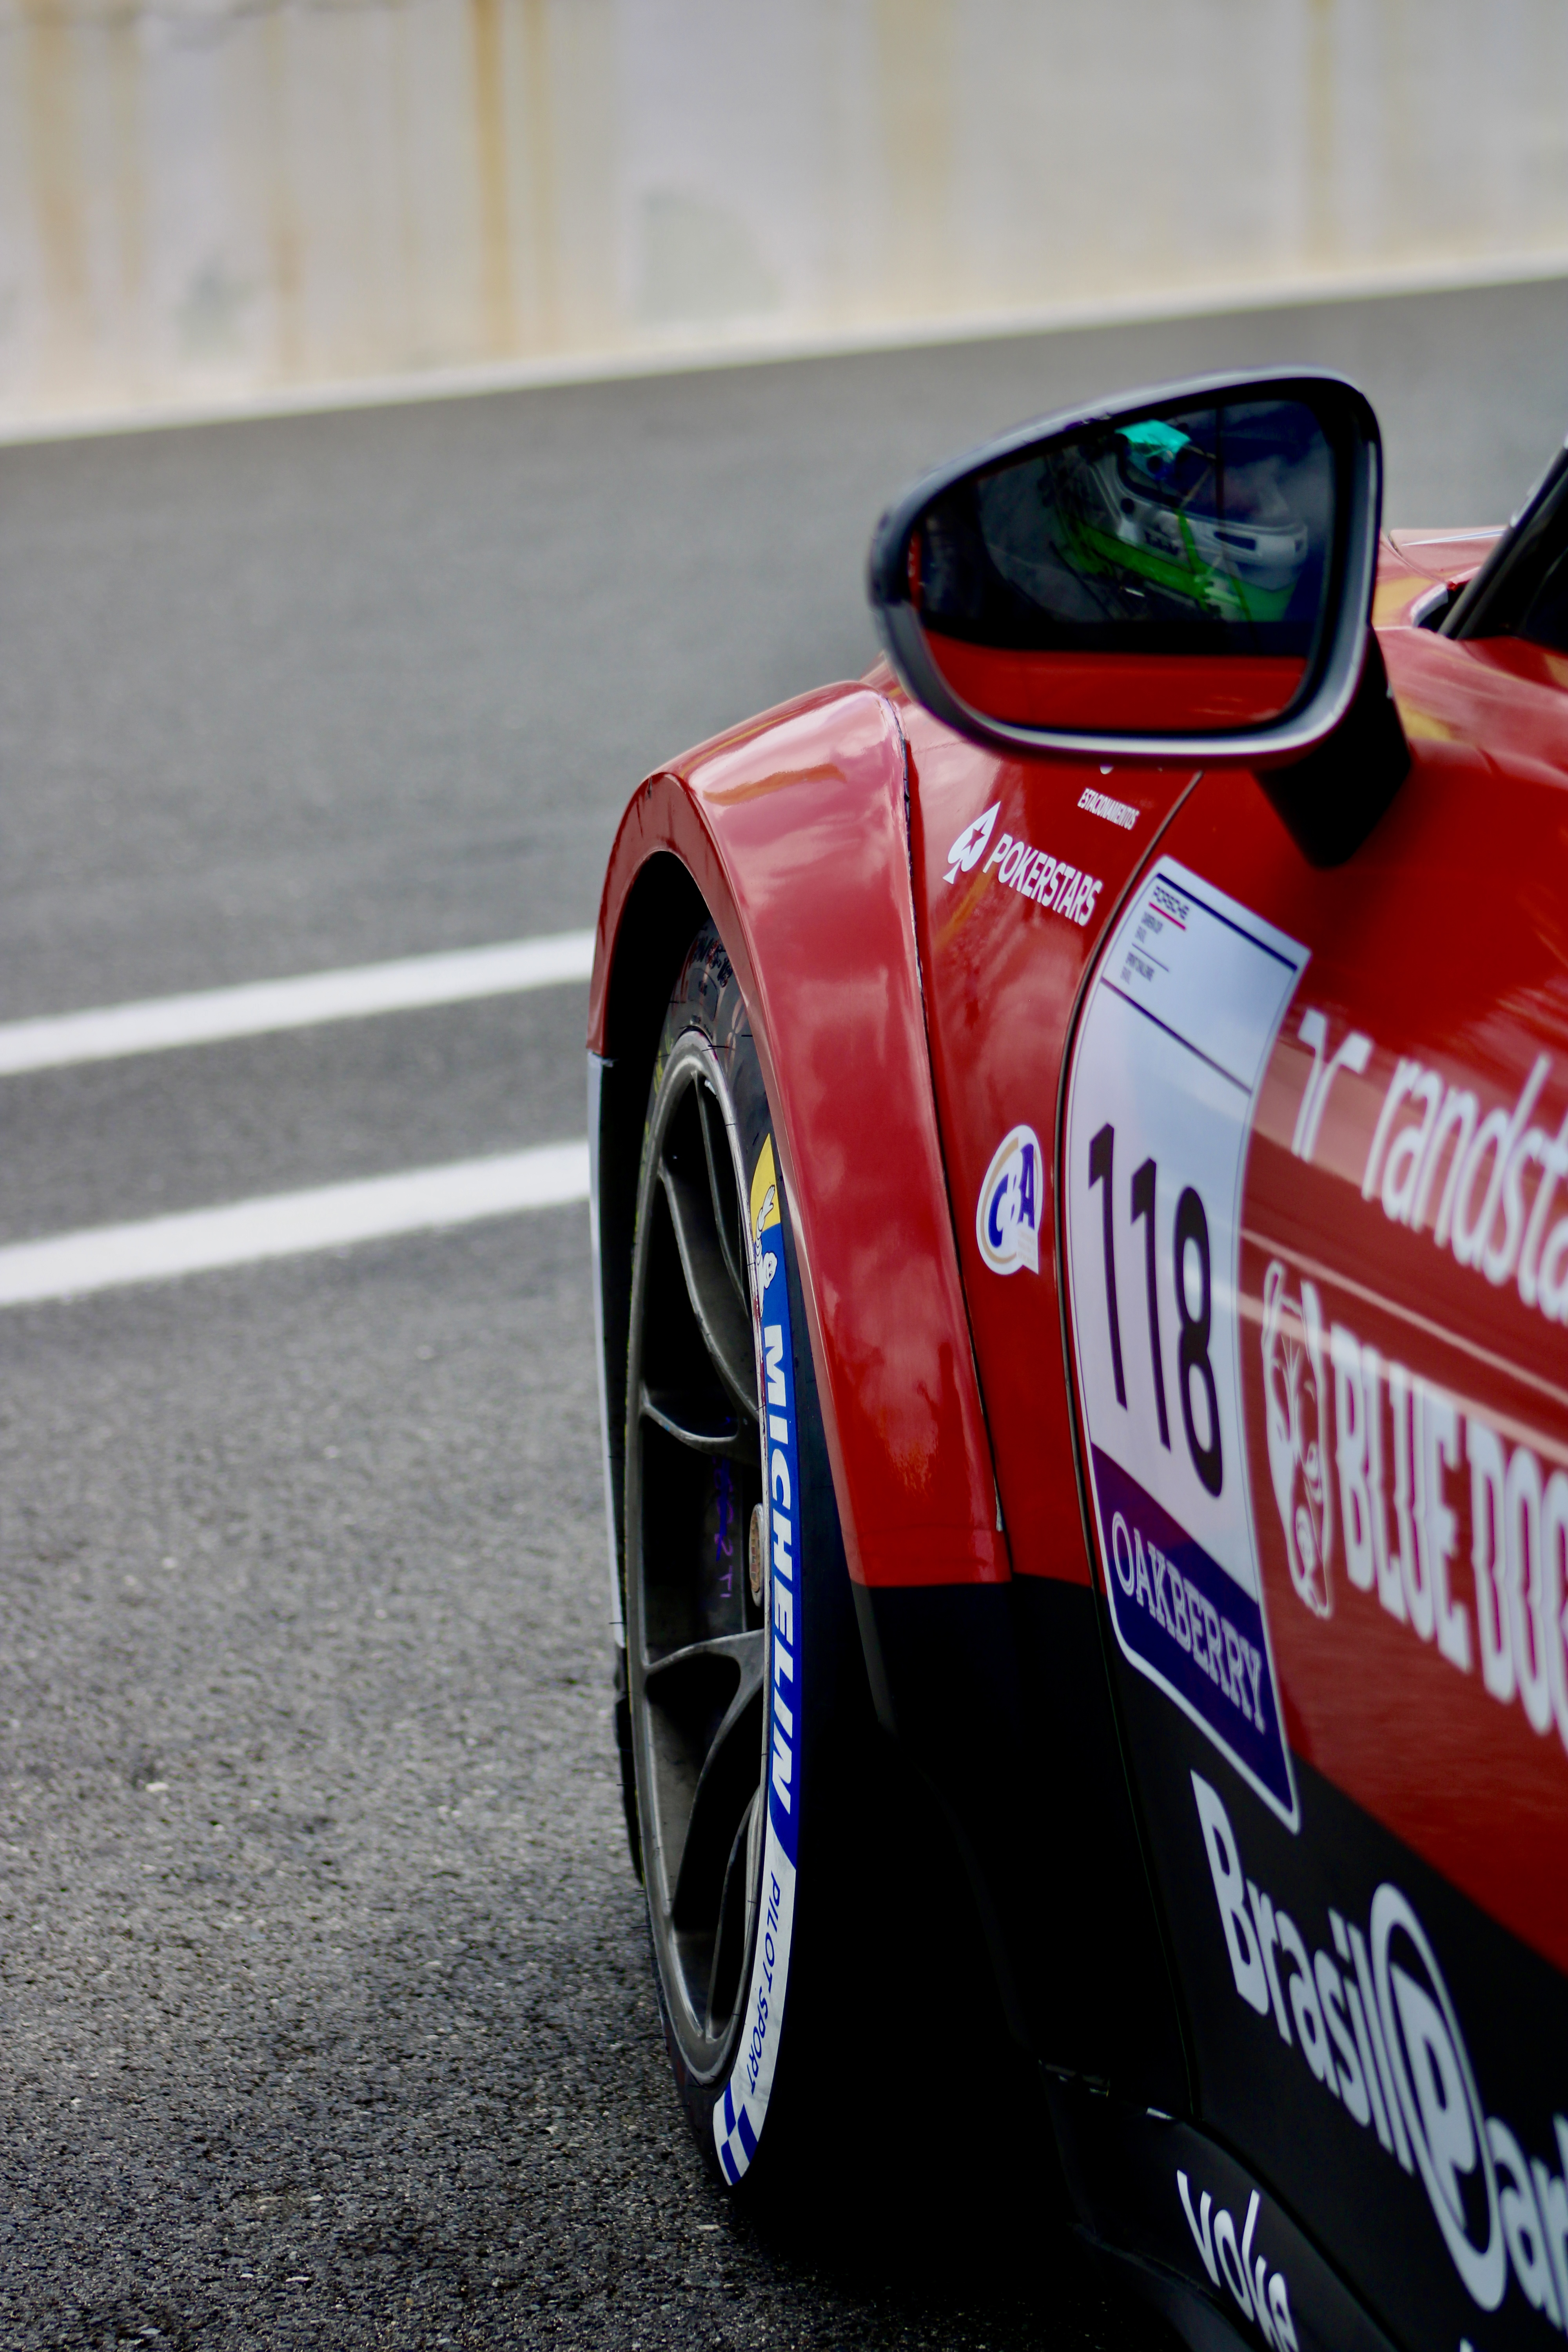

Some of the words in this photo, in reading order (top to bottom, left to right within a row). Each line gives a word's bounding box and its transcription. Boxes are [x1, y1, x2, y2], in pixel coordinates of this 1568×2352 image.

[982, 833, 1103, 926] POKERSTARS
[1077, 788, 1140, 831] ESTACIONAMENTOS
[1089, 1122, 1223, 1498] 118
[764, 1324, 793, 1815] MICHELIN
[1330, 1322, 1472, 1674] BLUE
[1112, 1511, 1265, 1735] OAKBERRY
[763, 1870, 780, 1994] PILOT
[747, 1985, 768, 2095] SPORT
